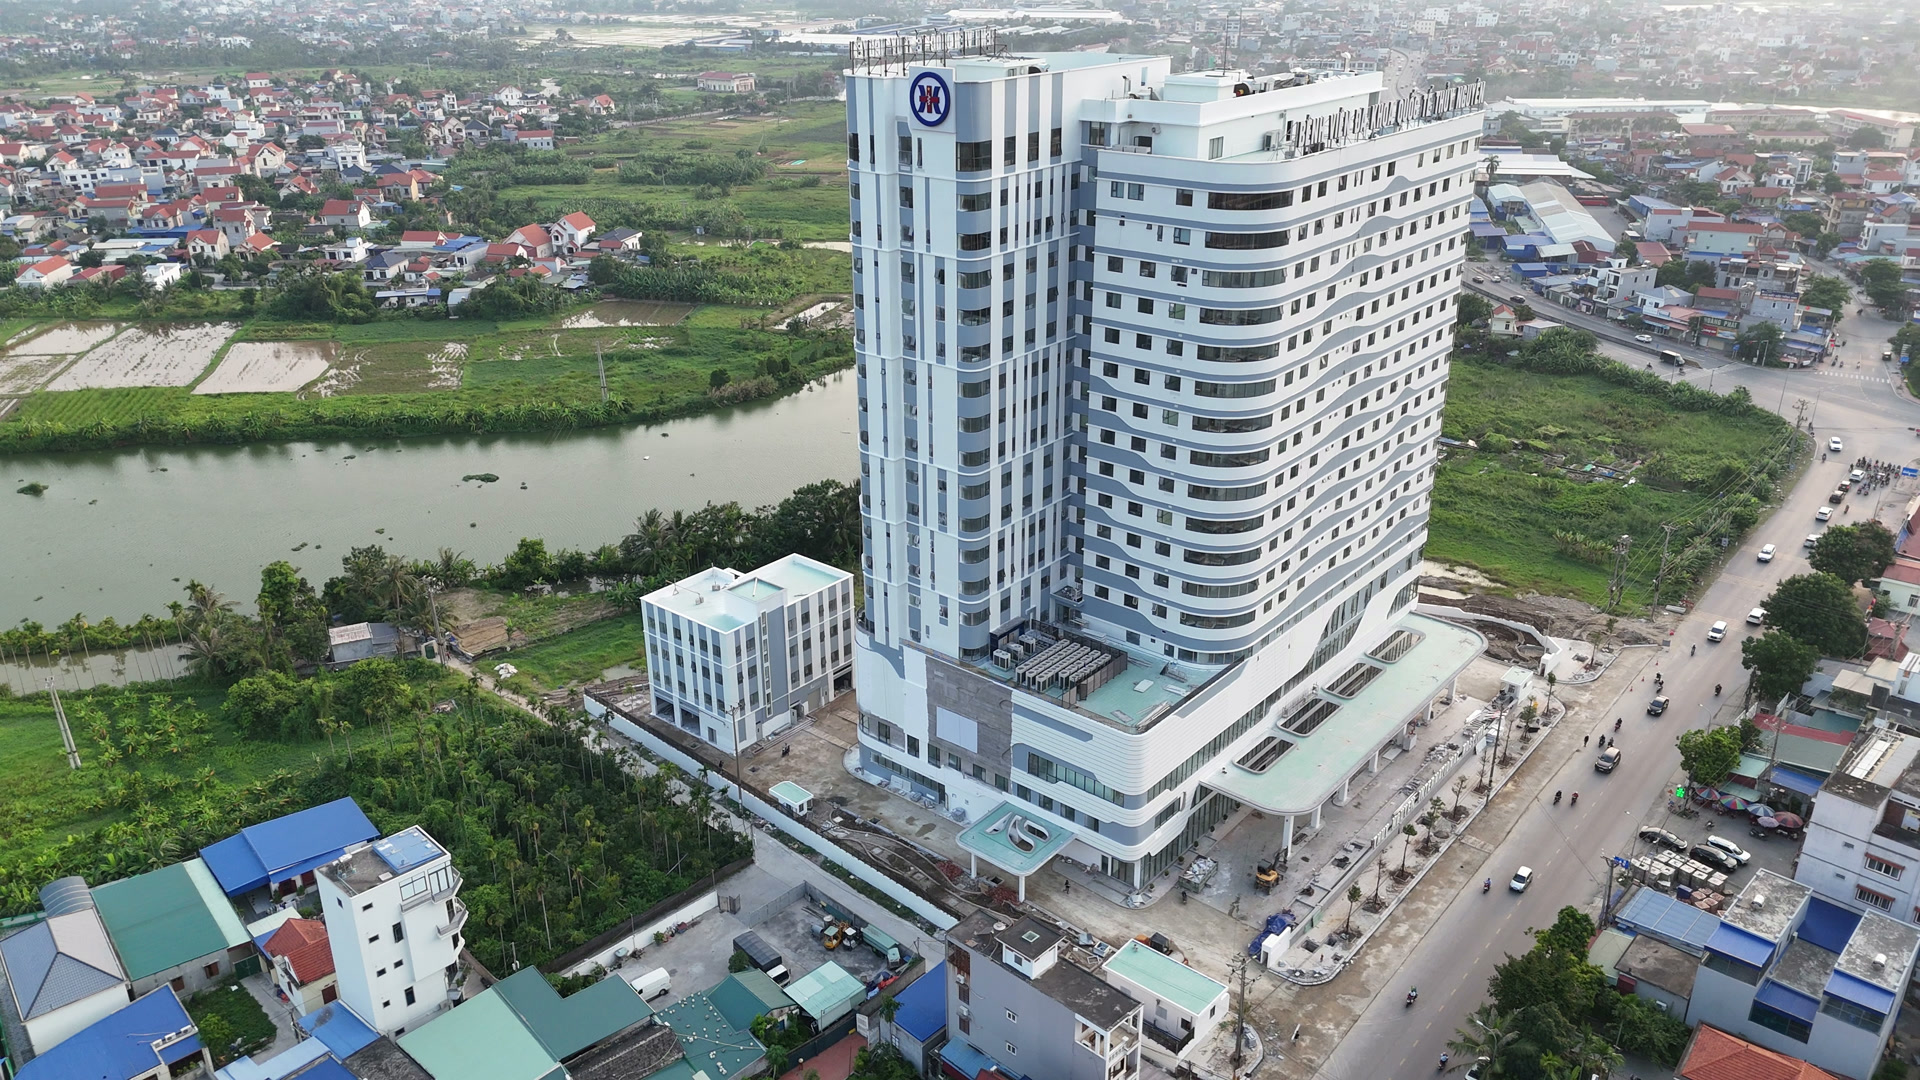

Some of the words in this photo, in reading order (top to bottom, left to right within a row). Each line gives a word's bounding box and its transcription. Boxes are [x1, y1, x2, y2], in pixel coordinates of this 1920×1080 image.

[1297, 114, 1324, 148] BỆNH
[1328, 107, 1350, 143] VIỆN
[1369, 101, 1395, 129] KHOA
[1396, 89, 1420, 125] QUỐC
[1421, 85, 1433, 117] TẾ
[1455, 77, 1486, 109] NGUYÊN
